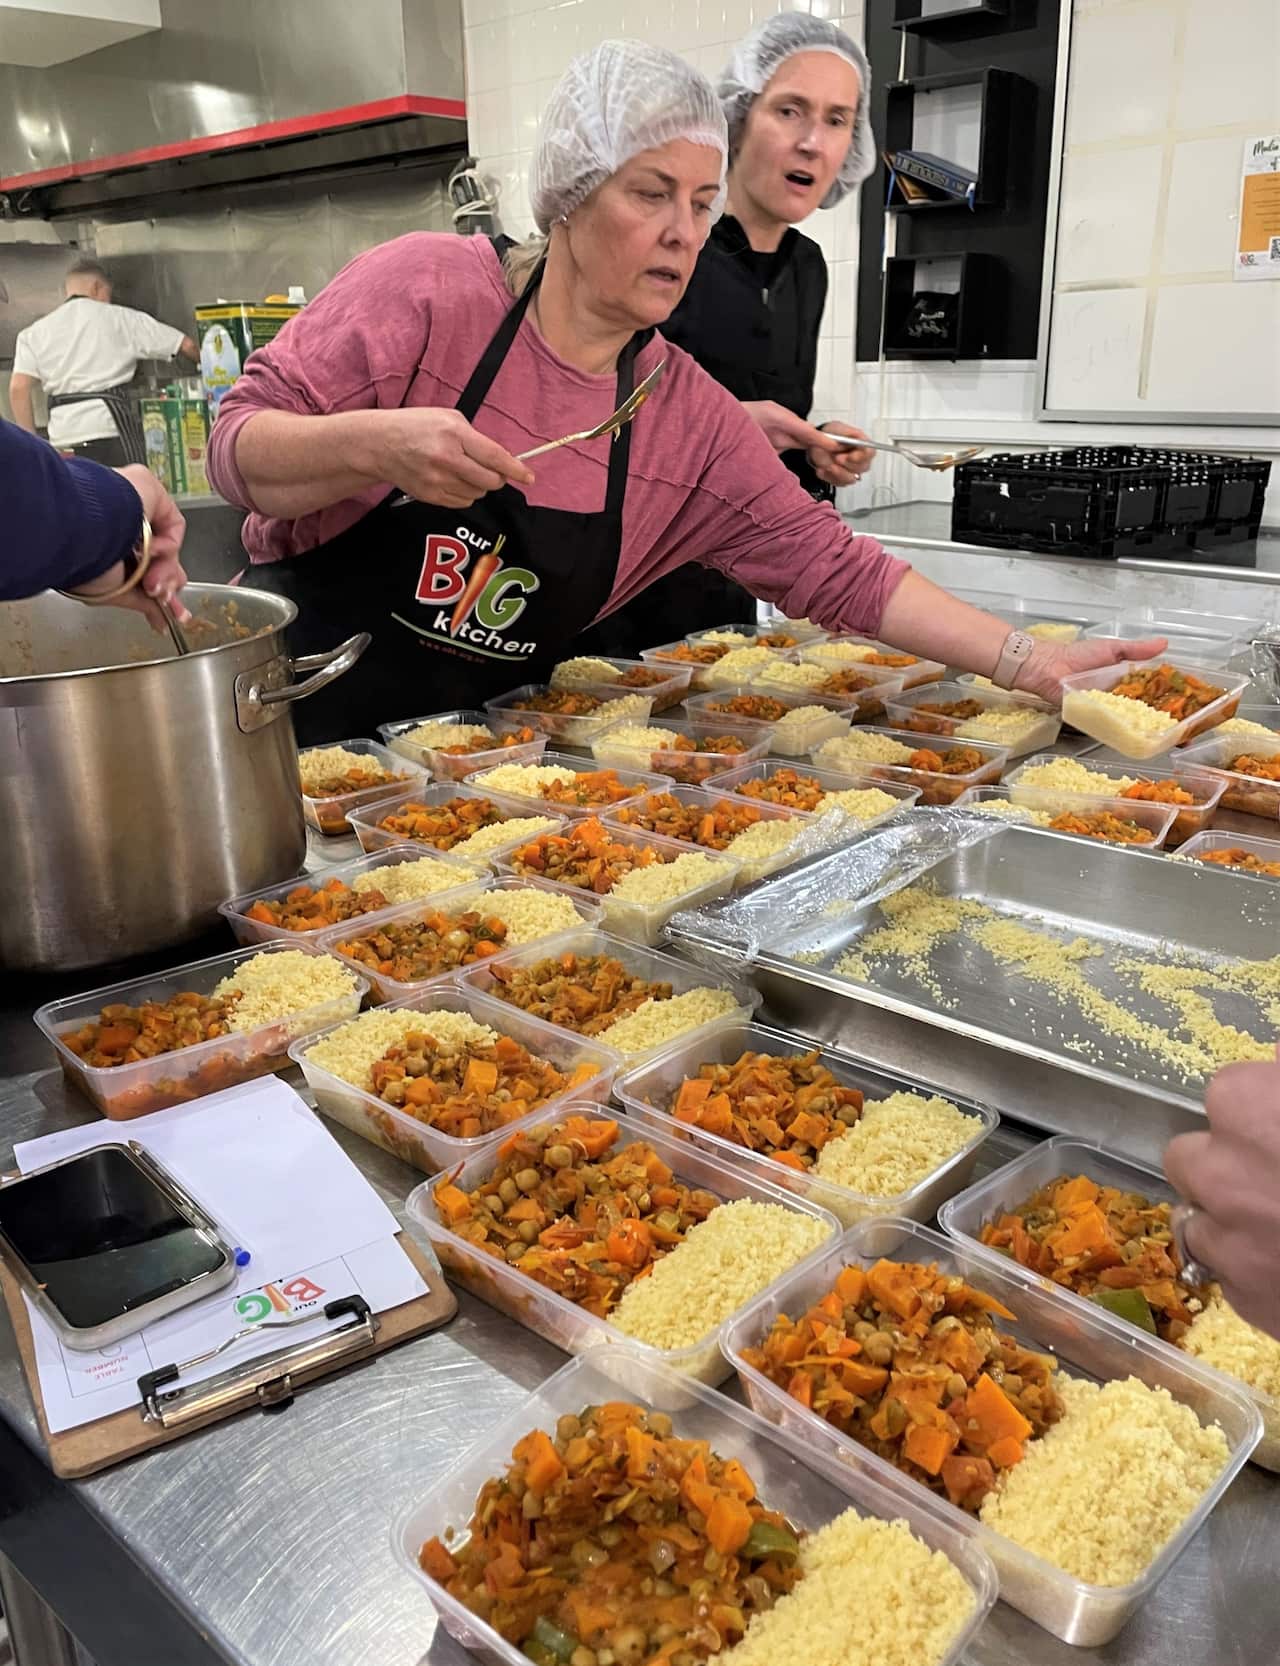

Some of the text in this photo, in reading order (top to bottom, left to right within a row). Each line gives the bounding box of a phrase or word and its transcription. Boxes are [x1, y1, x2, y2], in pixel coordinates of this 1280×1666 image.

[456, 526, 492, 551] our
[415, 533, 540, 633] BIG
[235, 1276, 327, 1323] BIG
